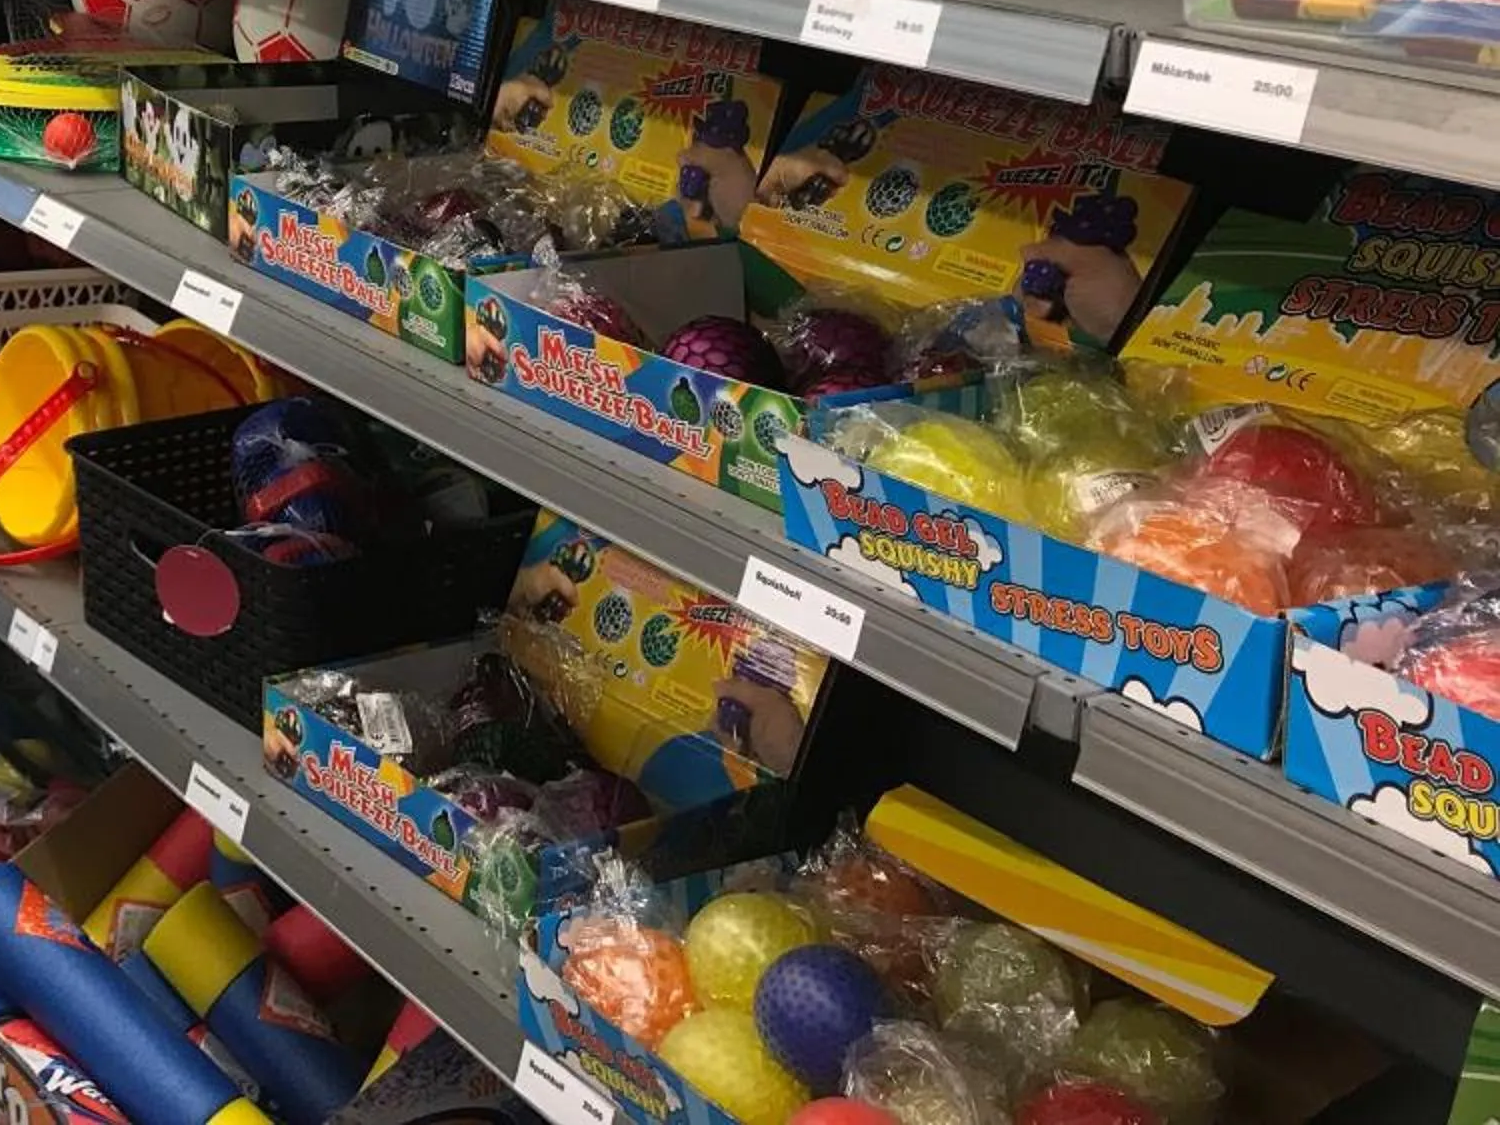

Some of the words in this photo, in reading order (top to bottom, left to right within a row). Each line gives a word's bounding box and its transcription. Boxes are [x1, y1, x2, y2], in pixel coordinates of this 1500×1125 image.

[1252, 79, 1294, 98] 25:00
[258, 228, 342, 291] SQUEEZE
[340, 264, 397, 317] BALL
[279, 210, 337, 261] MESH
[1280, 275, 1472, 339] STRESS
[536, 325, 626, 394] MESH
[509, 343, 632, 426] SQUEEZE
[630, 393, 713, 461] BALL
[821, 479, 909, 537] BEAD
[912, 511, 978, 558] GEL
[859, 528, 982, 591] SQUISHY
[989, 580, 1116, 643] STRESS
[1117, 610, 1226, 673] TOYS
[329, 740, 398, 808] MESH
[1358, 709, 1495, 794] BEAD
[300, 753, 400, 837] SQUEEZE
[397, 814, 463, 880] BALL
